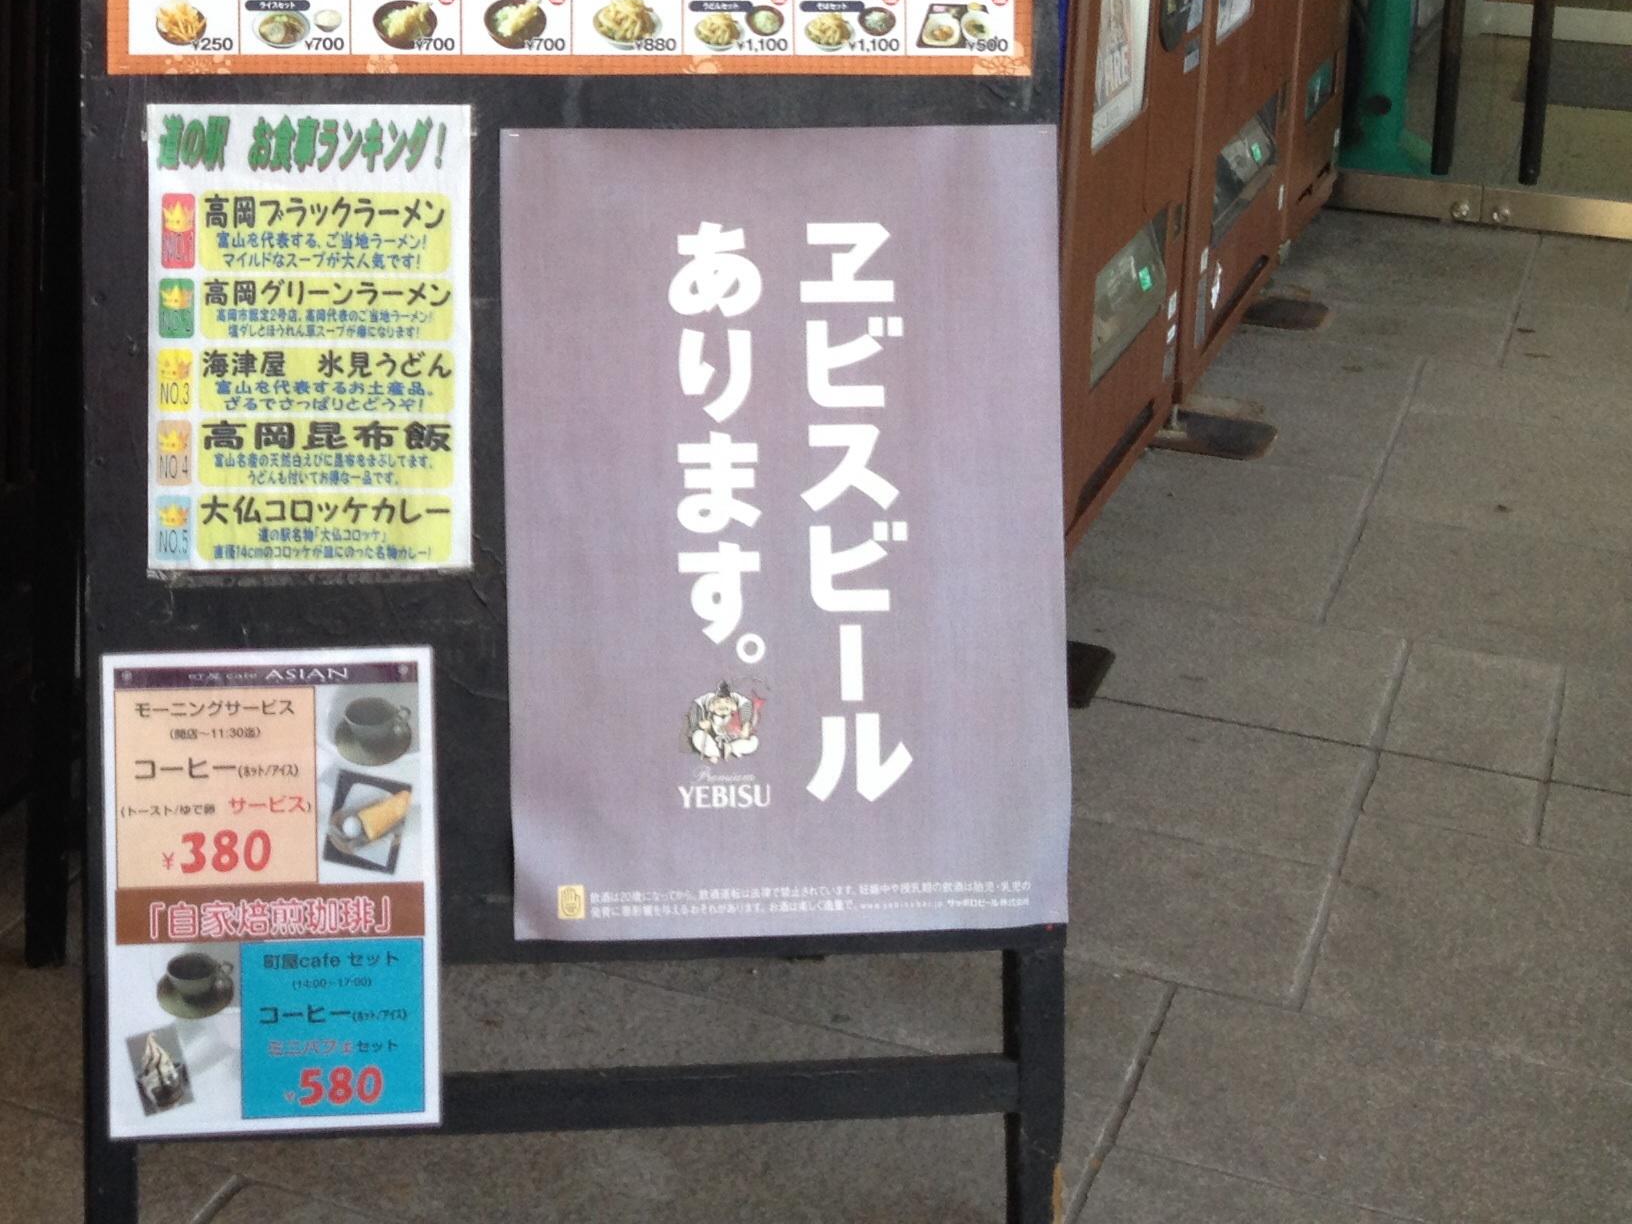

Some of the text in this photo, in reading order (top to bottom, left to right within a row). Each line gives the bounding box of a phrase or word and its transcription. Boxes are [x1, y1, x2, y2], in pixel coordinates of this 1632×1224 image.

[192, 38, 233, 50] ¥250
[302, 38, 344, 50] ¥700
[524, 38, 565, 50] ¥700
[634, 38, 676, 52] ¥880
[734, 38, 787, 52] ¥1,100
[966, 38, 1008, 52] ¥500
[204, 195, 445, 229] 高岡ブラックラーメン
[204, 280, 452, 307] 高岡グリーンラーメン
[202, 351, 452, 377] 海津屋 氷見うどん
[160, 383, 190, 405] NO.3
[201, 421, 451, 451] 高岡昆布飯
[667, 221, 765, 664] あります。
[201, 495, 450, 525] 大仏コロッケカレー
[800, 222, 913, 803] ヱビスビール
[266, 667, 348, 681] ASIAN
[135, 700, 294, 718] モーニングサービス
[678, 783, 771, 808] YEBISU
[162, 830, 272, 874] ¥380
[348, 950, 400, 968] セット
[356, 1039, 399, 1053] セット
